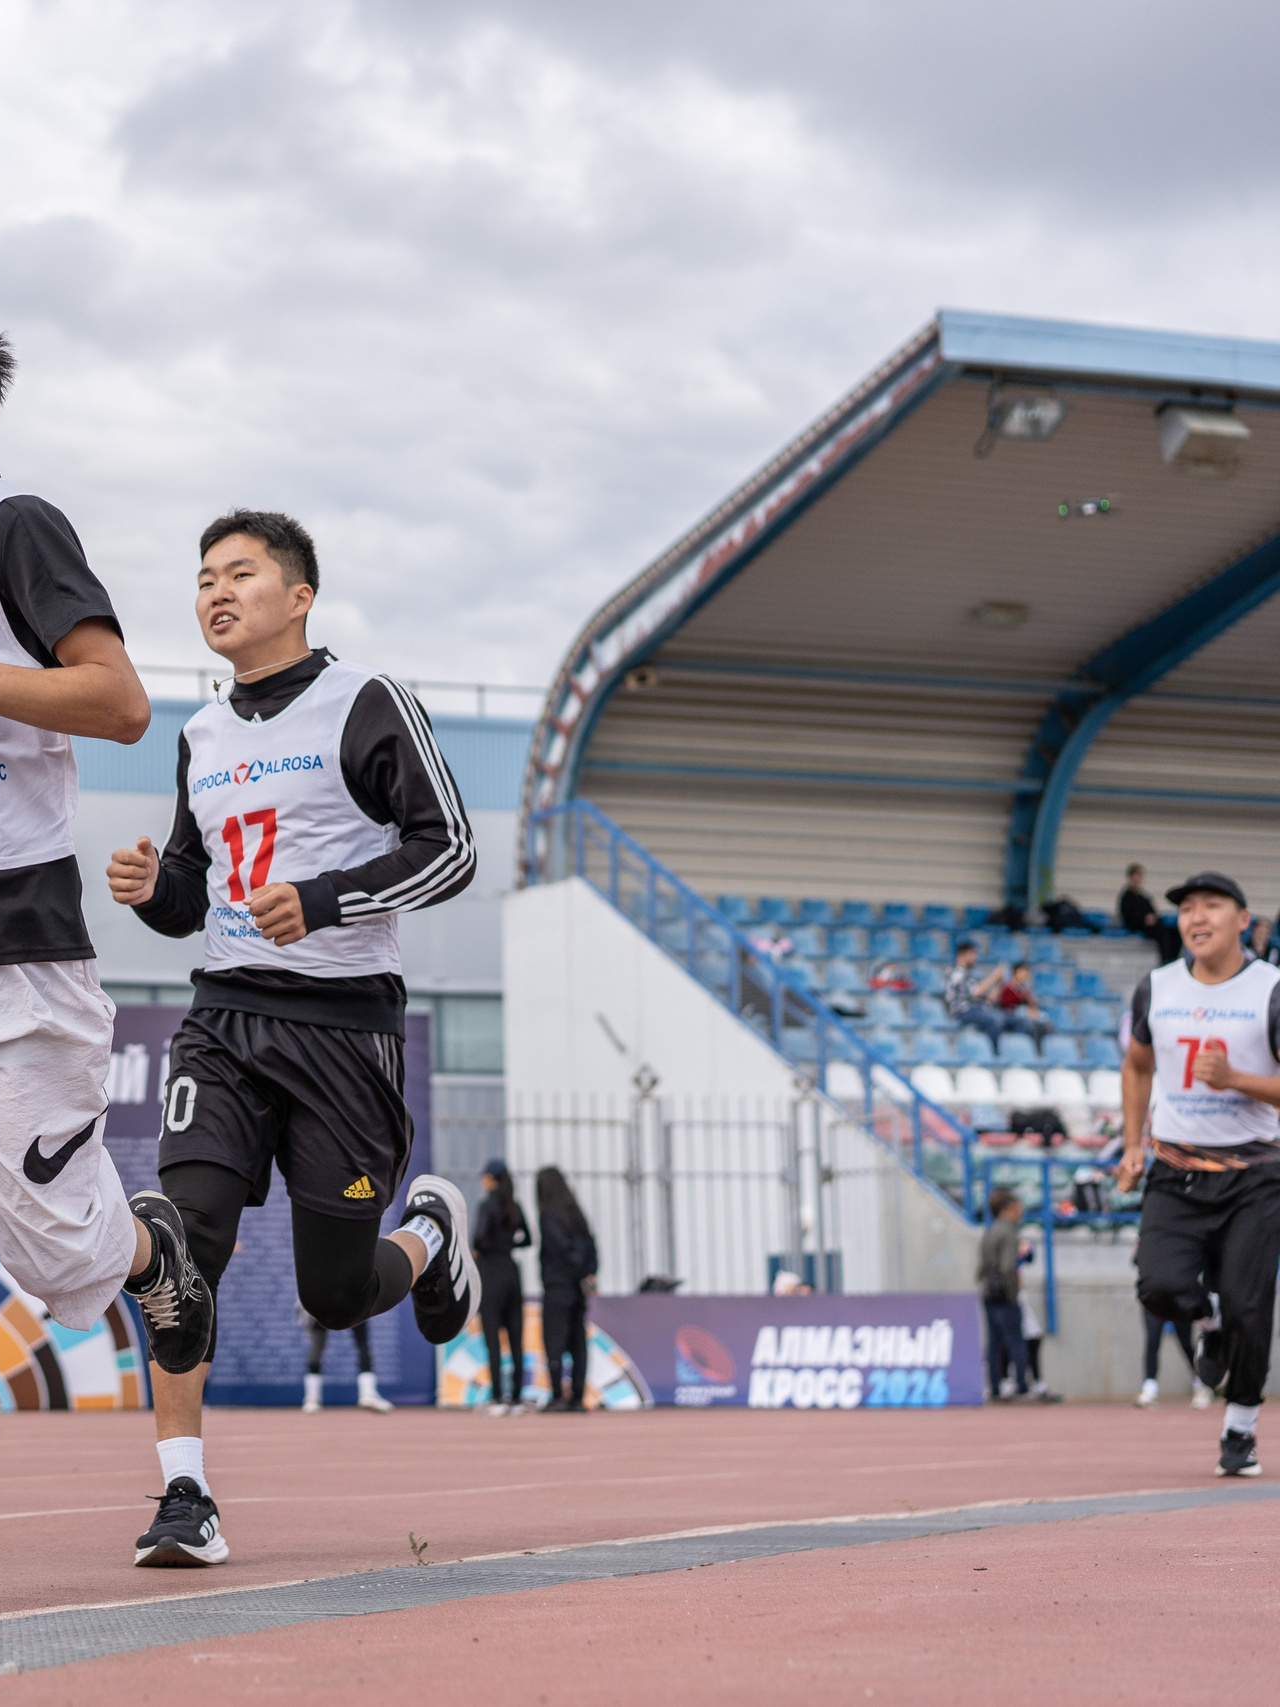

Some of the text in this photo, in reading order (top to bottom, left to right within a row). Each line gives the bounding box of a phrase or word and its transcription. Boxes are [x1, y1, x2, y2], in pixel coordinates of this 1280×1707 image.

[264, 754, 324, 776] ALROSA
[221, 807, 278, 902] 17
[158, 1076, 197, 1141] 0
[343, 1189, 376, 1199] adidas
[751, 1318, 954, 1368] АЛМАЗНЫЙ
[747, 1368, 864, 1409] КРОСС
